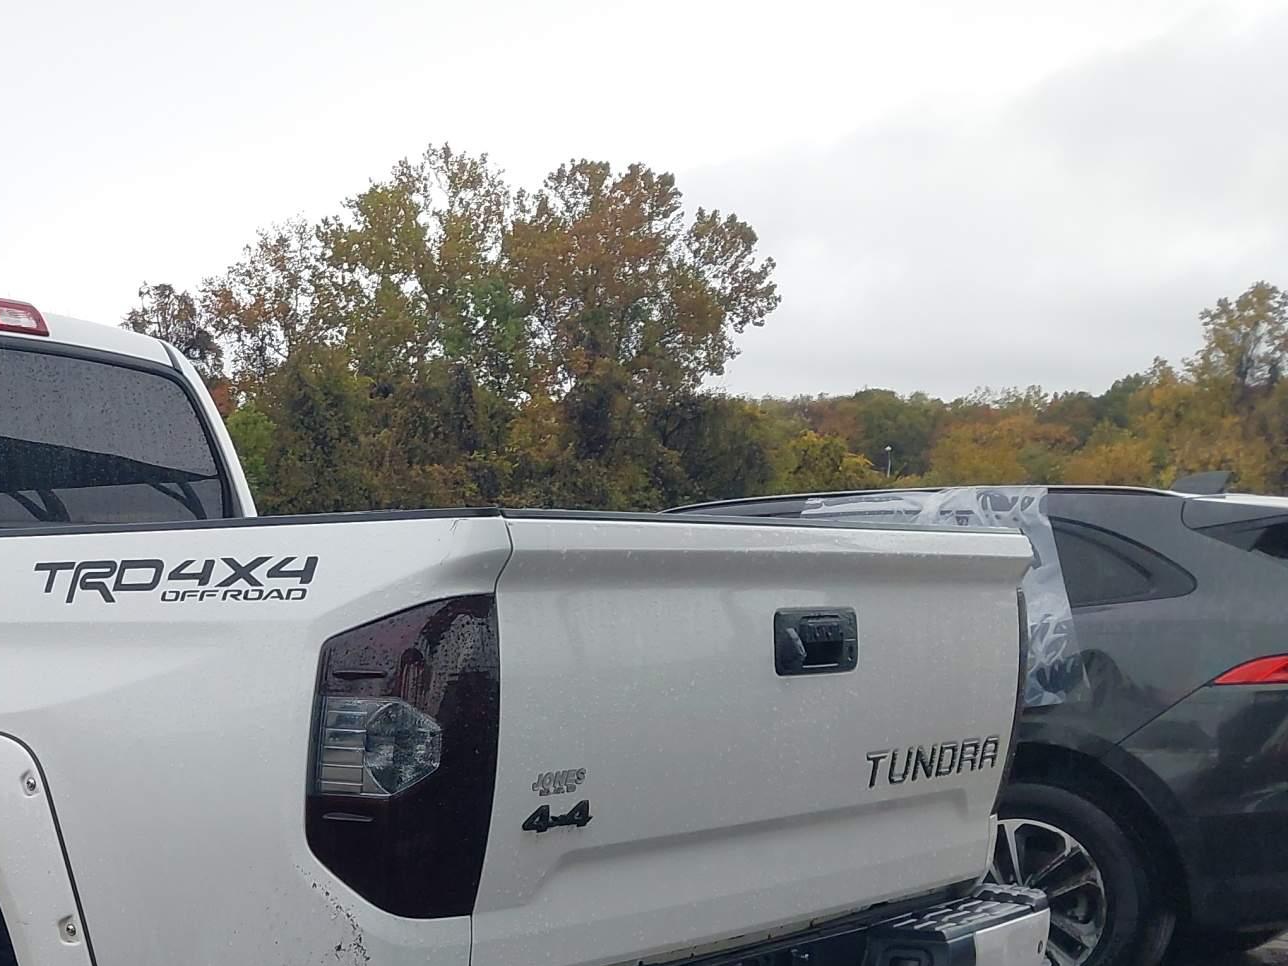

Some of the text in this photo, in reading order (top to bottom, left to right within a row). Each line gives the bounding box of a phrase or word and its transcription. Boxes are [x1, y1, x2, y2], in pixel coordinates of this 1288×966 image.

[161, 588, 308, 602] OFF ROAD
[866, 735, 999, 789] TUNDRA
[532, 767, 587, 792] JONES
